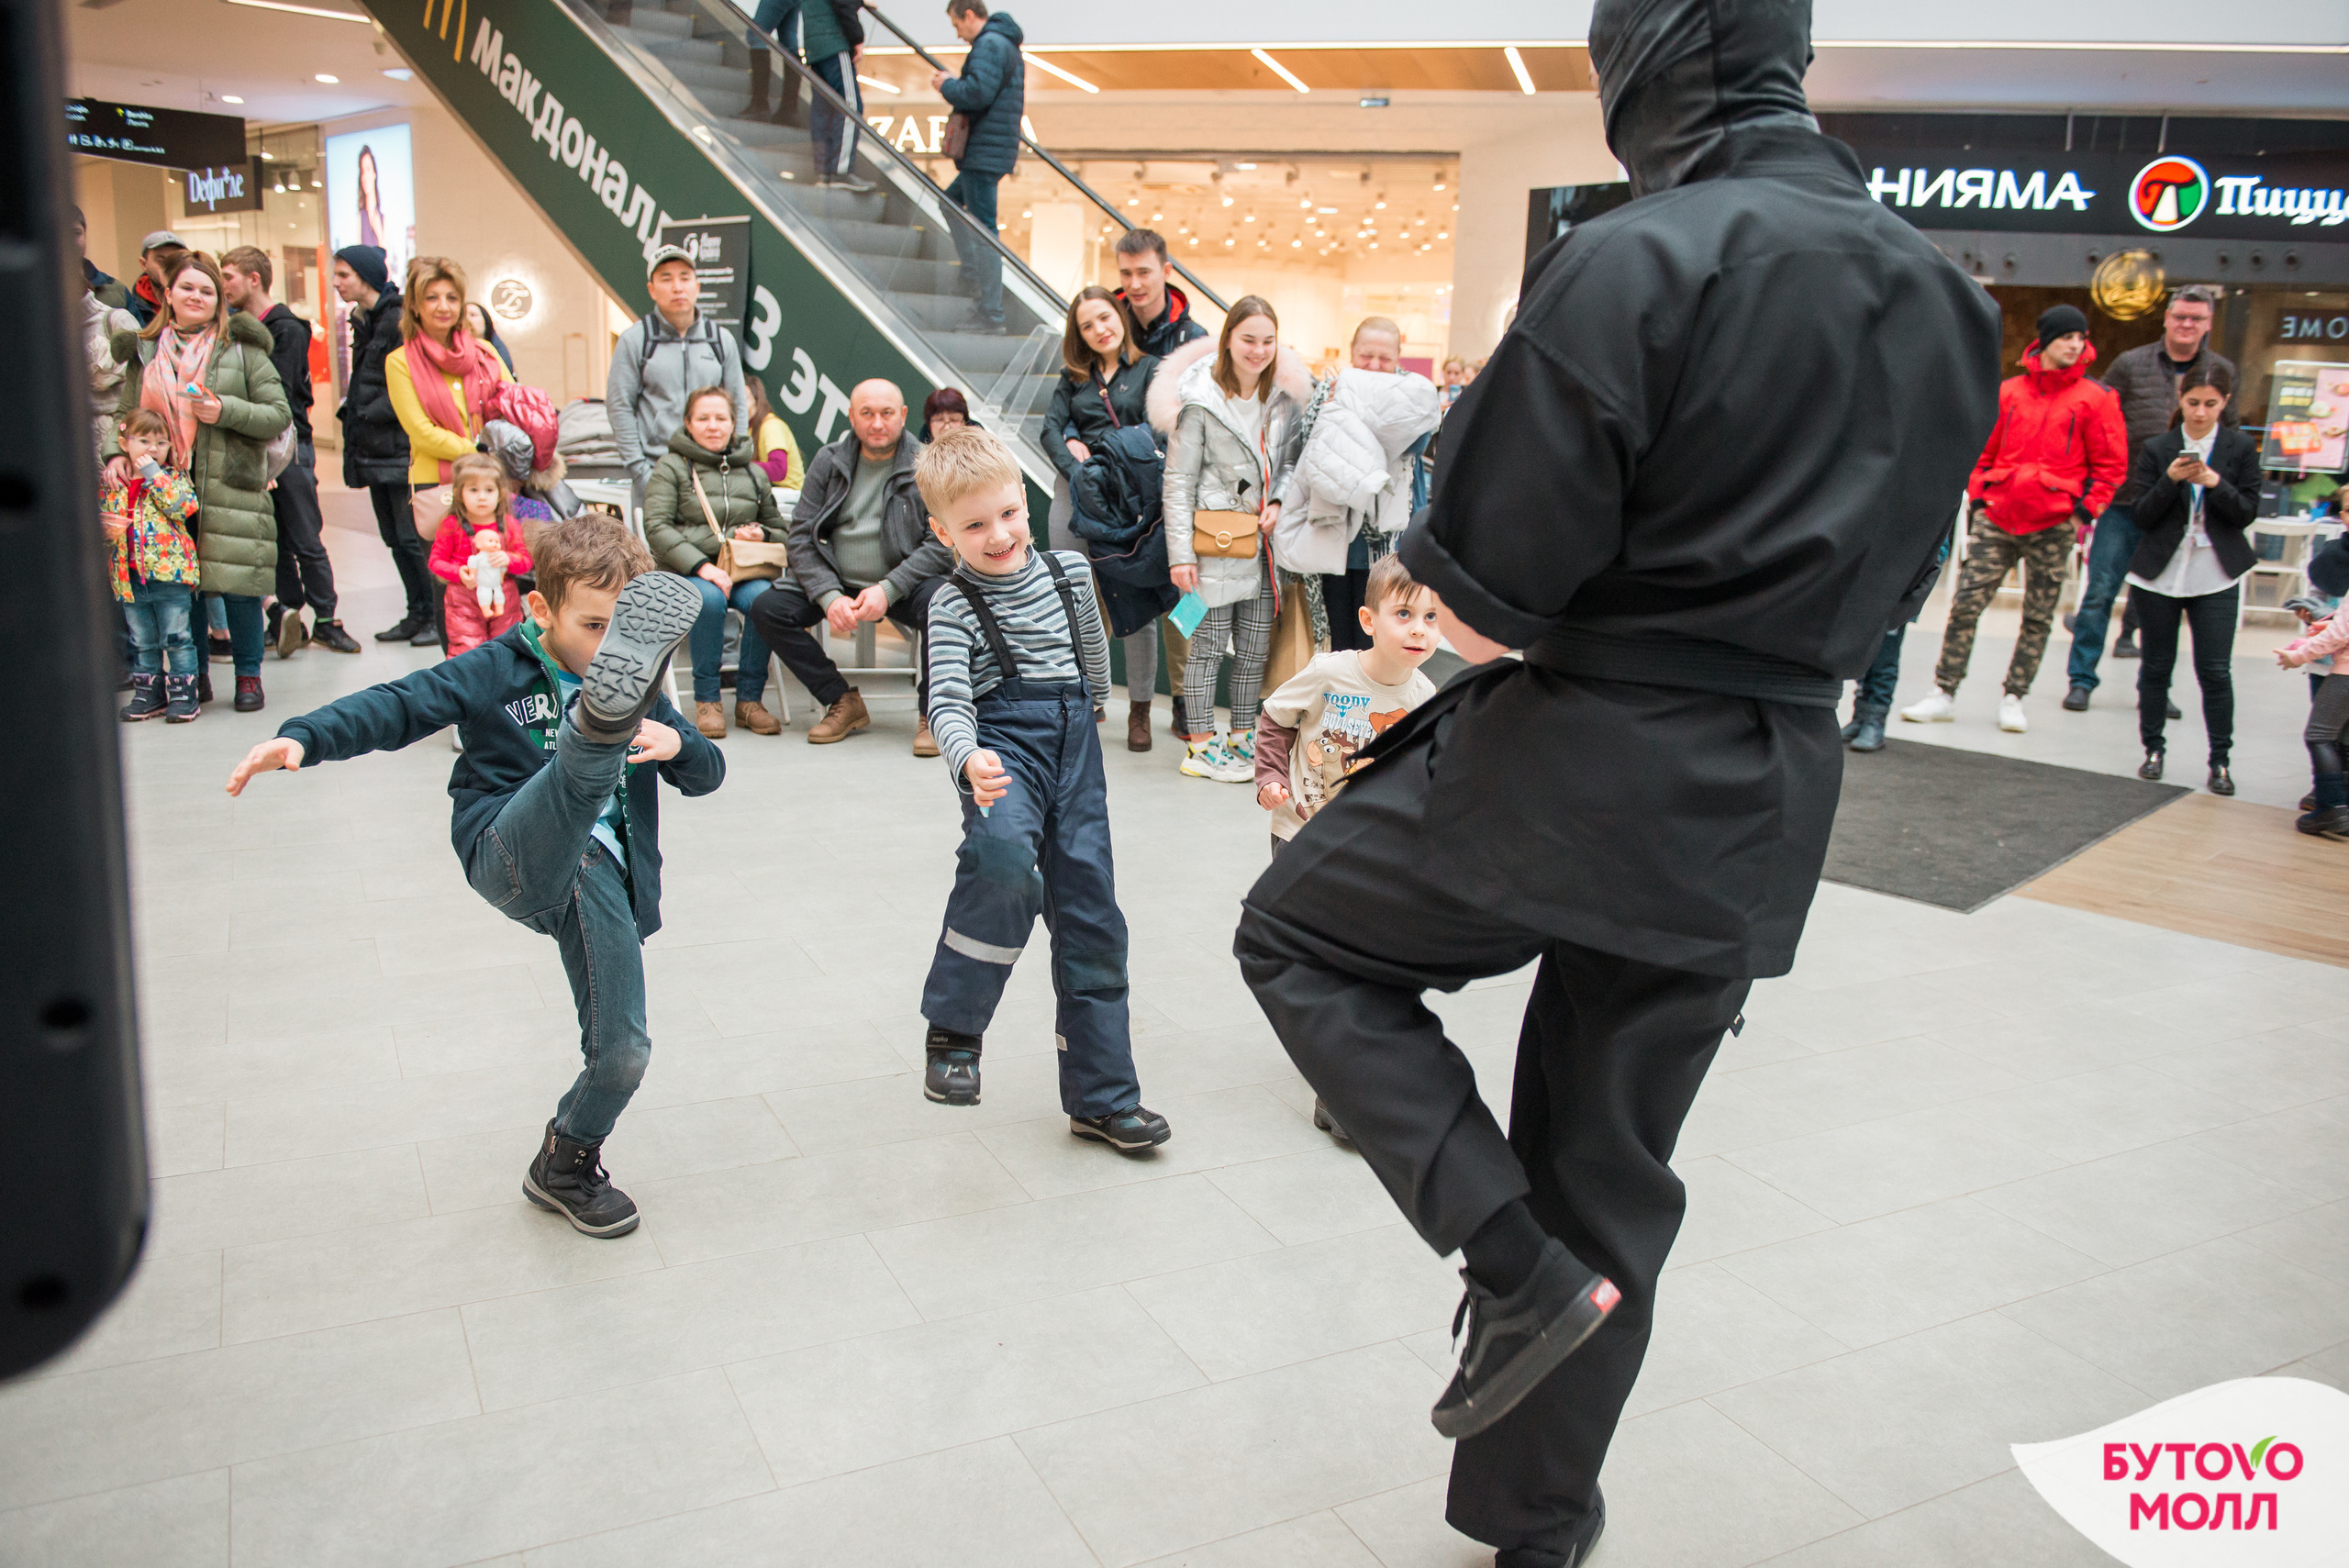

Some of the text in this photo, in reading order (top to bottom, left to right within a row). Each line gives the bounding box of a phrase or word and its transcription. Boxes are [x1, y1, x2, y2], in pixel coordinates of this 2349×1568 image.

[1865, 167, 2097, 211] НИЯМА
[2214, 175, 2349, 226] Пицц
[744, 284, 782, 372] 3
[780, 347, 852, 445] эт
